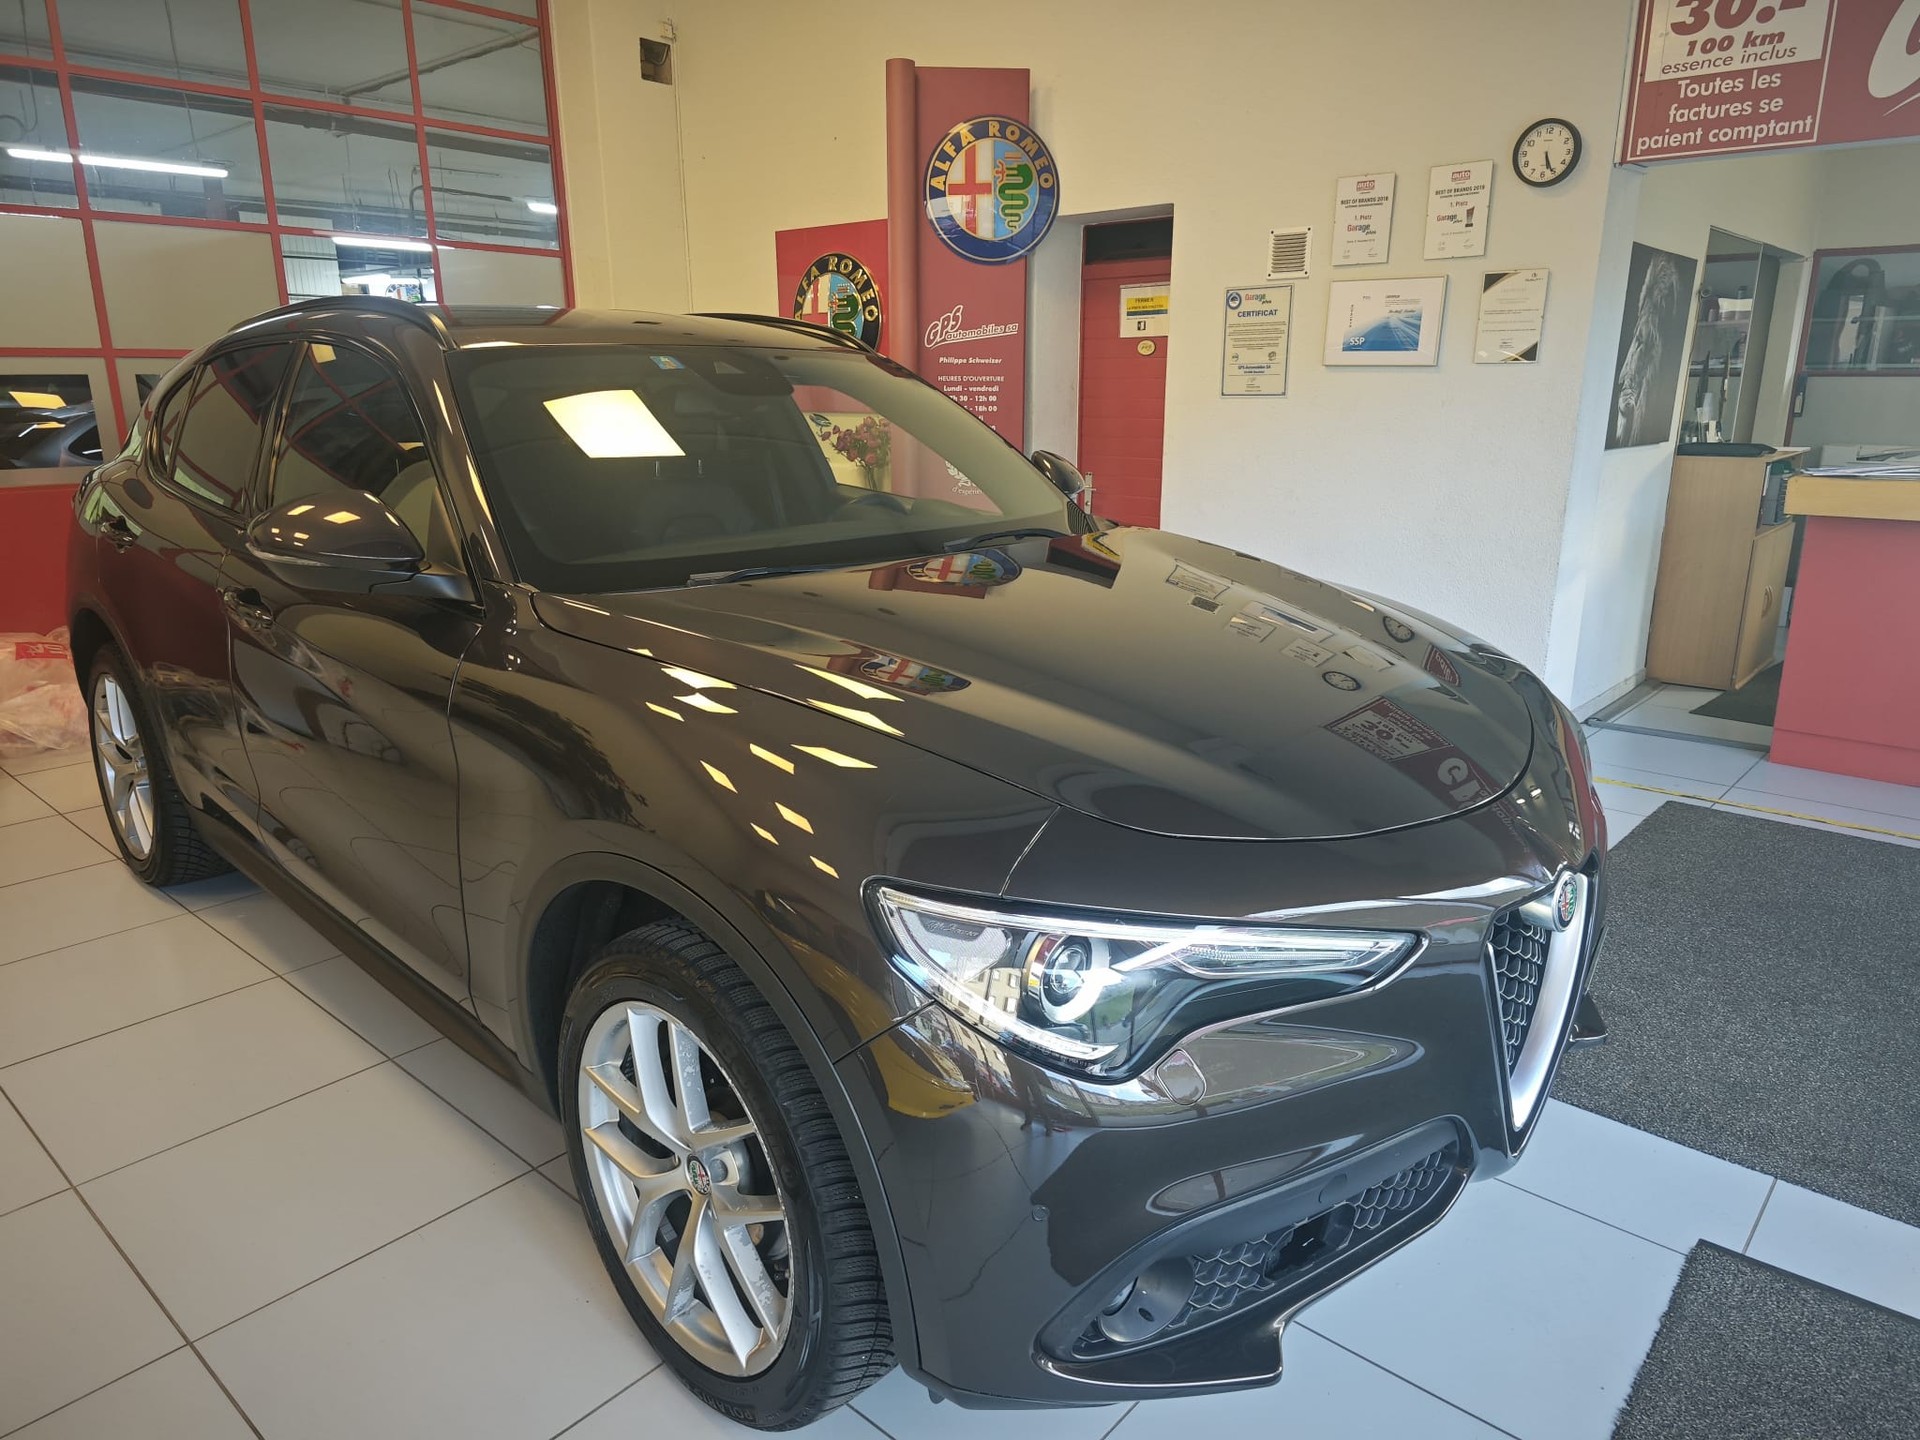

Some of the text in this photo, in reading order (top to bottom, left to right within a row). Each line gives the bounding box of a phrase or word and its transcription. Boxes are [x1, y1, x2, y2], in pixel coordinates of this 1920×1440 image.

[1686, 31, 1785, 57] 100 km
[1661, 46, 1797, 75] essence inclus
[1678, 69, 1782, 98] Toutes les
[1668, 97, 1783, 124] factures se
[1636, 115, 1813, 155] paient comptant
[930, 120, 1054, 192] ALFA ROMEO
[1347, 223, 1371, 234] Garage
[1436, 213, 1458, 224] Garage
[828, 255, 879, 322] ROMEO
[1244, 293, 1267, 303] Garage
[924, 304, 1019, 348] GPS automobiles sa
[1237, 308, 1279, 318] CERTIFICAT
[1349, 336, 1366, 346] SSP
[938, 356, 1003, 365] Philippe Schweizer
[943, 384, 963, 392] Lundi
